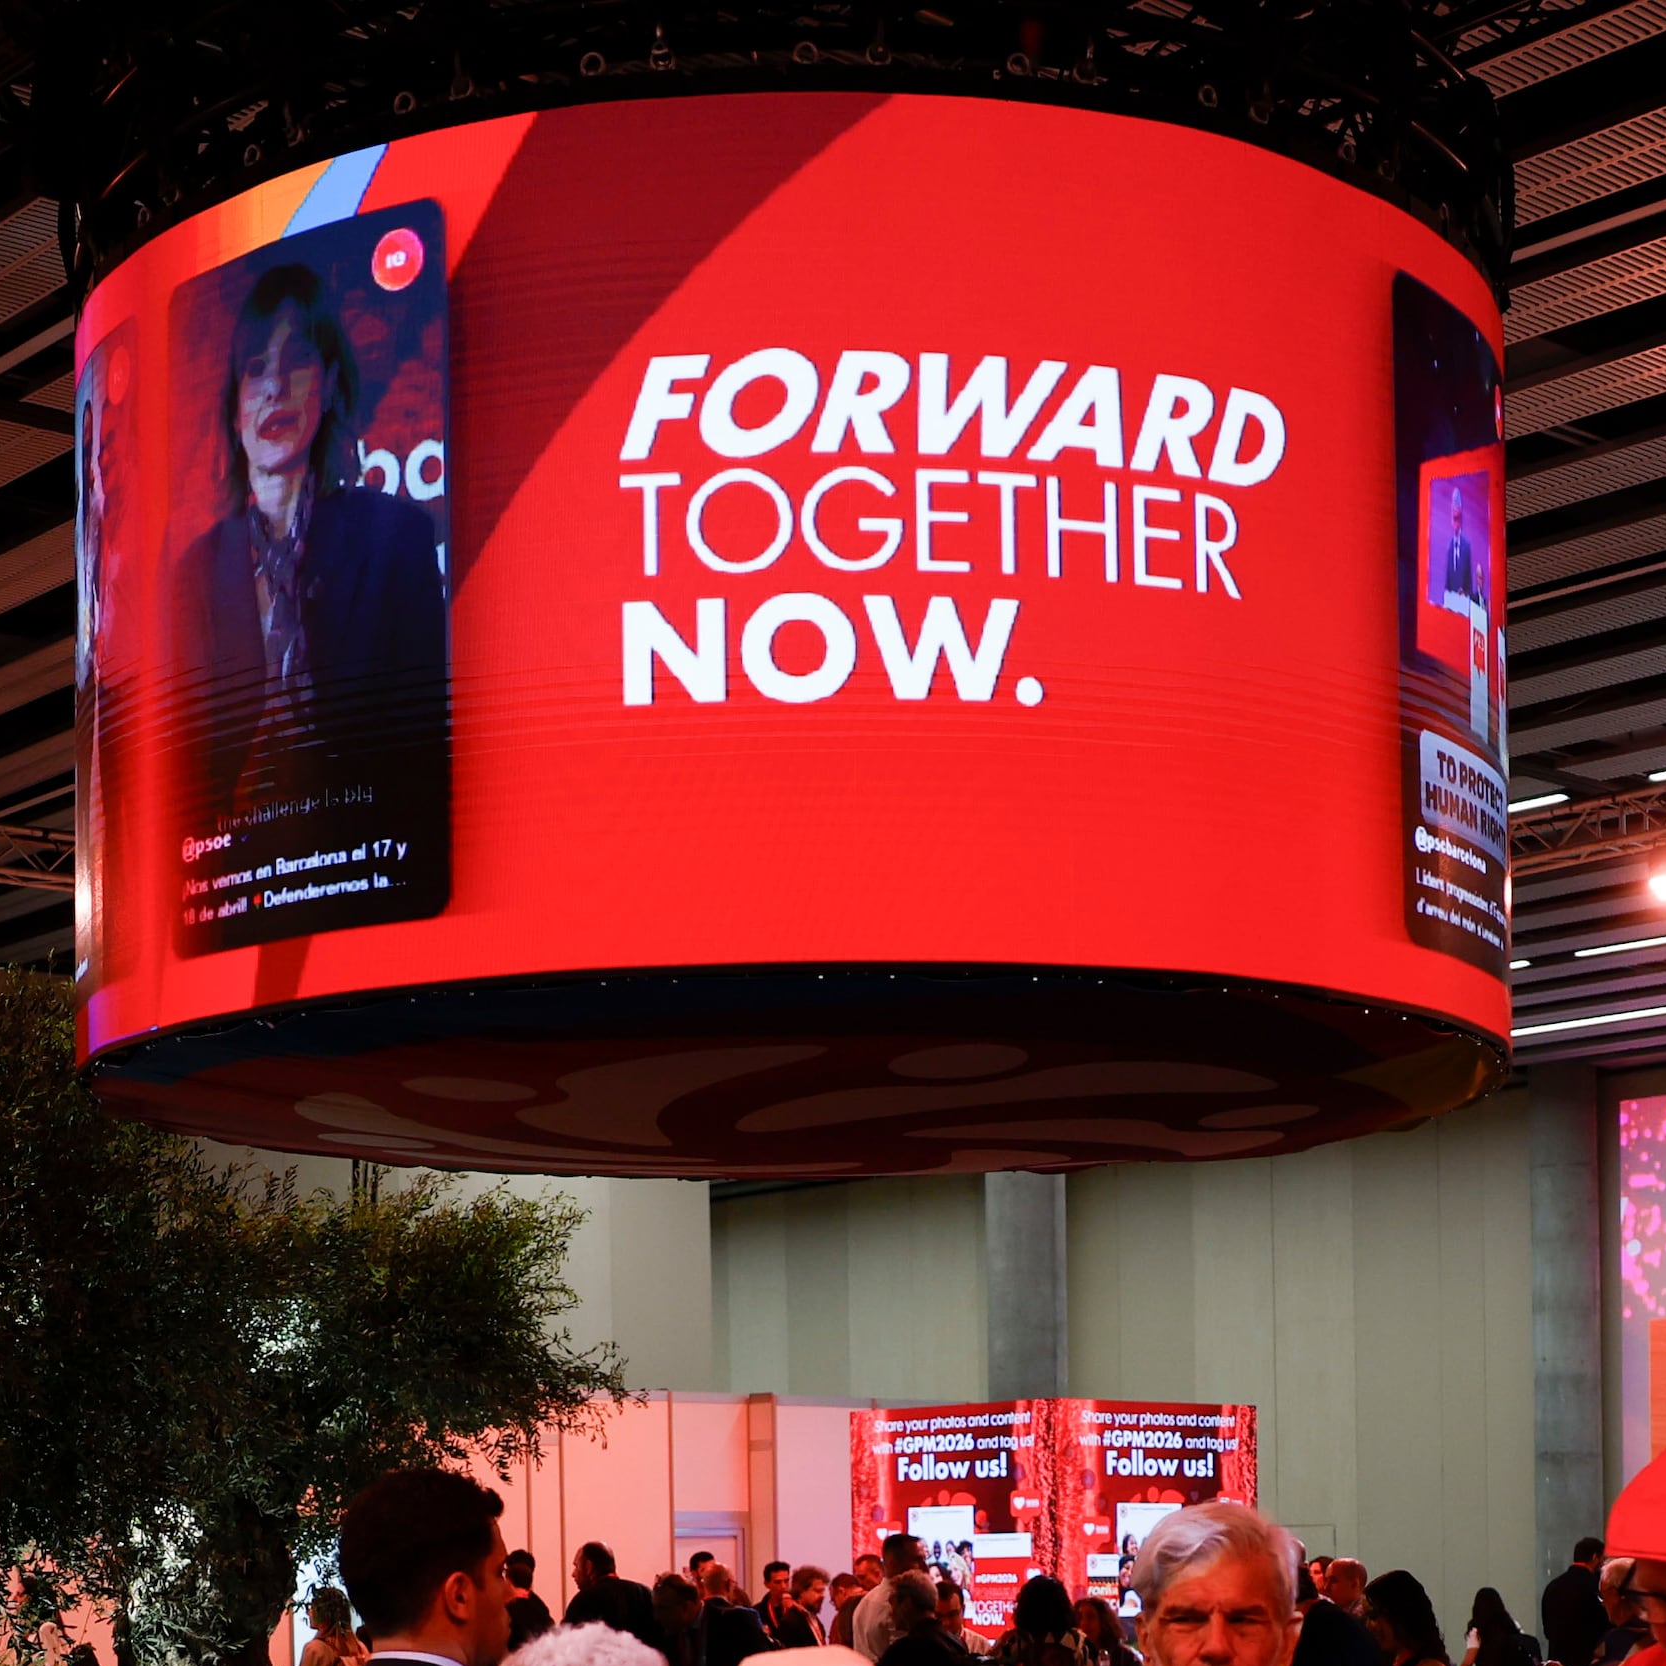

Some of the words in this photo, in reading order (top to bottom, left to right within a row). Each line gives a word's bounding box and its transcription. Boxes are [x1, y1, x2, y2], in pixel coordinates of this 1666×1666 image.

[619, 347, 1286, 487] FORWARD
[619, 465, 1241, 599] TOGETHER
[621, 592, 1044, 706] NOW.
[1437, 750, 1456, 785] TO
[1459, 761, 1503, 817] PROTECT
[1425, 781, 1478, 832] HUMAN
[182, 832, 231, 862] @psoe
[212, 869, 253, 889] vemos
[256, 864, 272, 881] en
[276, 850, 347, 876] Barcelona
[351, 842, 366, 861] el
[372, 838, 392, 858] 17
[396, 840, 407, 861] y
[199, 904, 214, 922] de
[263, 876, 369, 909] Defenderemos
[874, 1419, 904, 1433] Share
[906, 1420, 929, 1434] your
[930, 1415, 967, 1433] photos
[968, 1412, 989, 1427] and
[990, 1411, 1031, 1426] content
[1082, 1410, 1112, 1424] Share
[1113, 1412, 1138, 1428] your
[1139, 1412, 1175, 1428] photos
[1176, 1413, 1197, 1427] and
[1198, 1414, 1235, 1428] content
[872, 1440, 893, 1455] with
[894, 1433, 975, 1454] #GPM2026
[977, 1436, 999, 1450] and
[1000, 1435, 1017, 1450] tag
[1020, 1434, 1035, 1447] us!
[1079, 1434, 1101, 1447] with
[1102, 1429, 1184, 1449] #GPM2026
[1185, 1436, 1206, 1450] and
[1207, 1436, 1224, 1452] tag
[897, 1452, 970, 1482] Follow
[974, 1450, 1008, 1479] us!
[1105, 1449, 1179, 1477] Follow
[1183, 1452, 1215, 1478] us!
[972, 1612, 1006, 1626] NOW.
